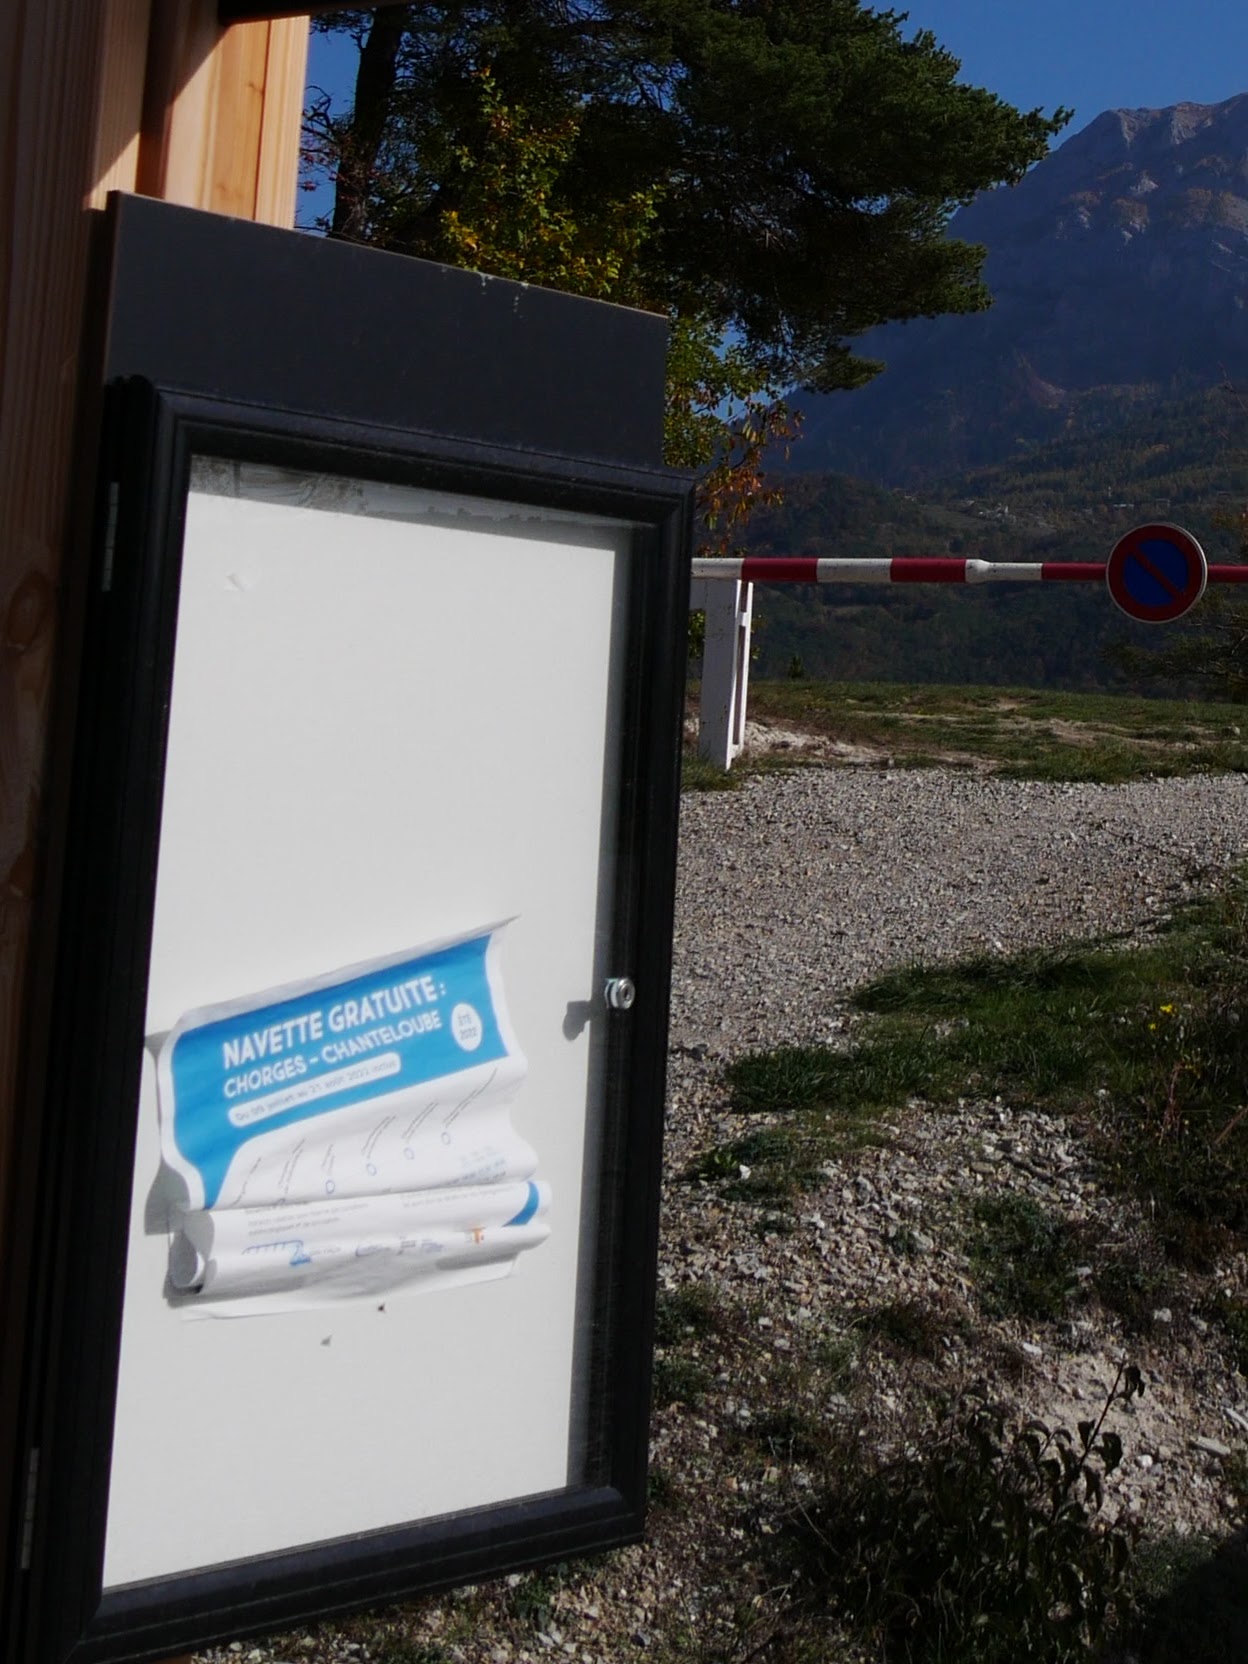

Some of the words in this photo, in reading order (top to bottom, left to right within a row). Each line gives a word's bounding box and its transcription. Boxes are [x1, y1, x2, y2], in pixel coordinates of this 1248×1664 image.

[222, 1009, 324, 1070] NAVETTE
[327, 974, 438, 1033] GRATUITE
[223, 1054, 308, 1099] CHORGES
[320, 1009, 443, 1065] CHANTELOUBE
